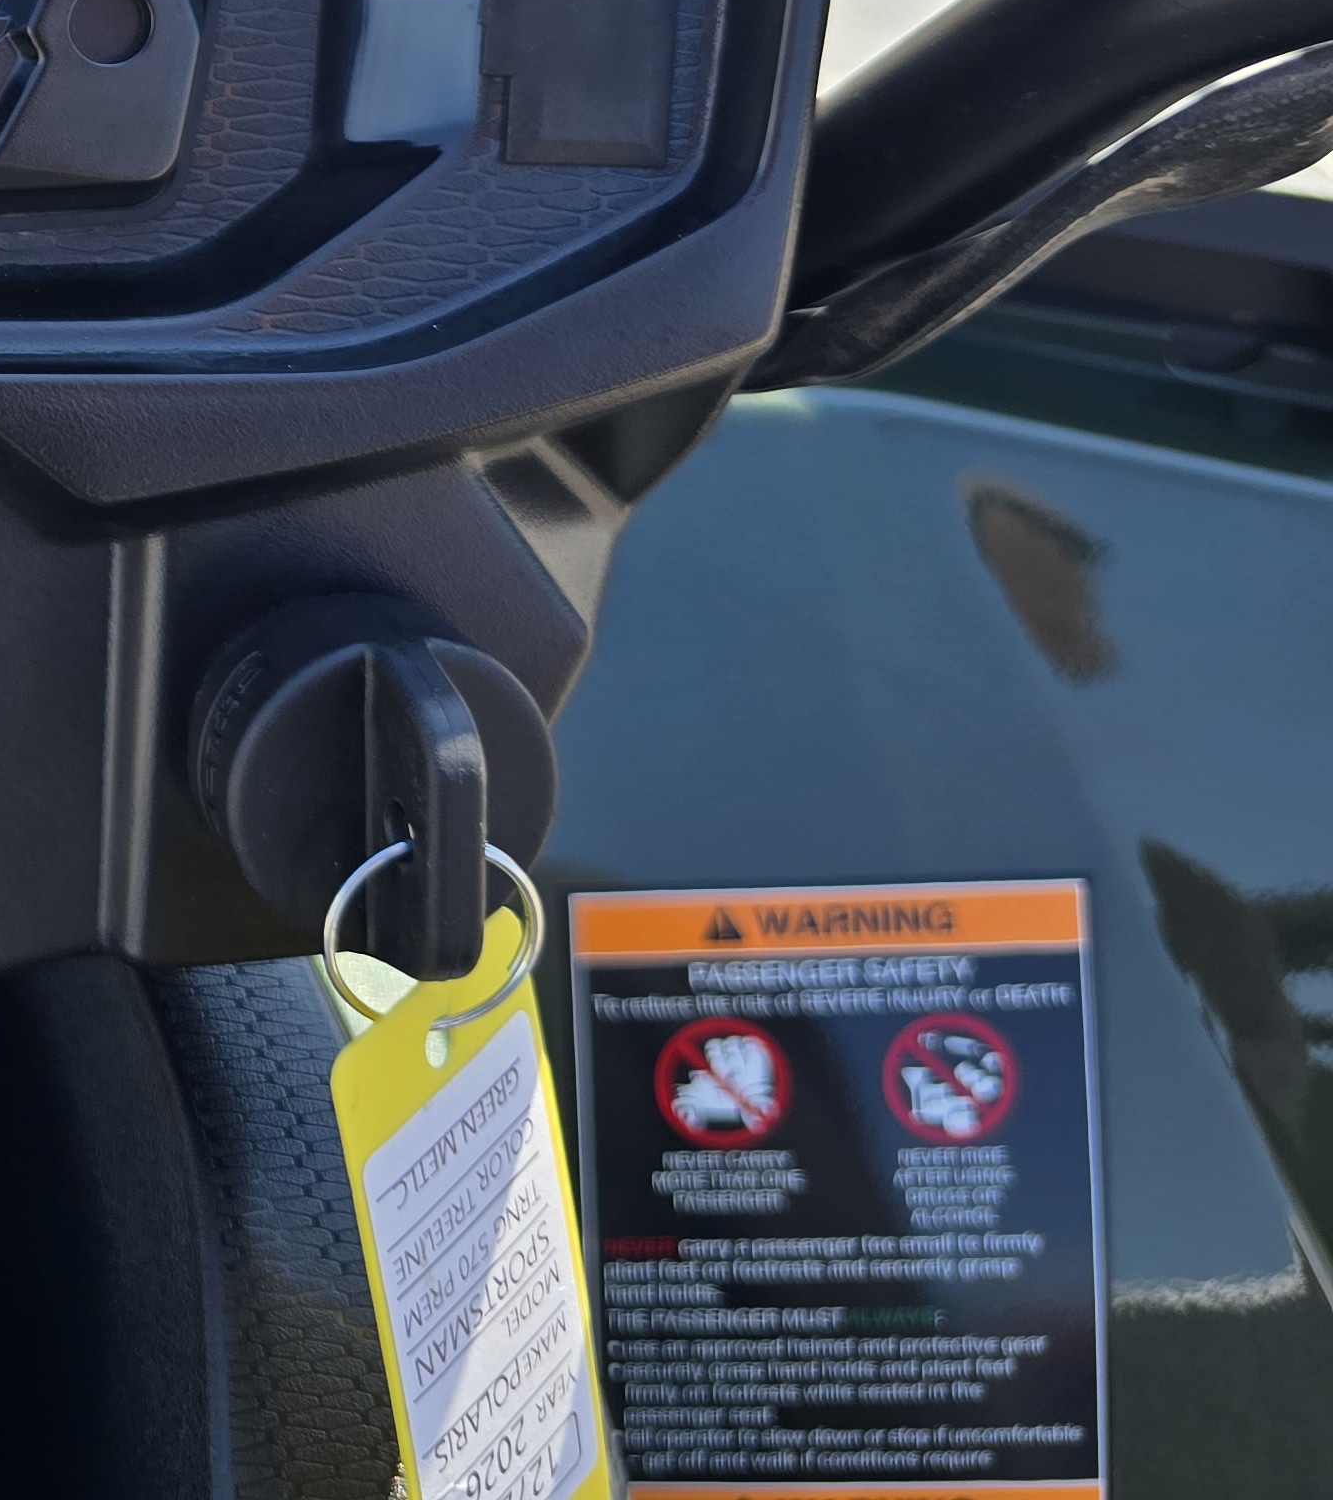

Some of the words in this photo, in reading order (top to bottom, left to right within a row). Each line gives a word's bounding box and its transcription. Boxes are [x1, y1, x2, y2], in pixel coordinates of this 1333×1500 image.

[754, 901, 954, 937] WARNING
[459, 1065, 520, 1144] GREEN
[475, 1116, 534, 1192] COLOR
[392, 1187, 478, 1286] TREELINE
[492, 1179, 542, 1243] TRNG
[457, 1230, 490, 1282] 570
[403, 1267, 456, 1339] PREM
[414, 1219, 551, 1387] SPORTSMAN
[500, 1259, 561, 1338] MODEL
[433, 1356, 527, 1474] POLARIS
[535, 1365, 578, 1424] YEAR
[464, 1414, 529, 1500] 2026
